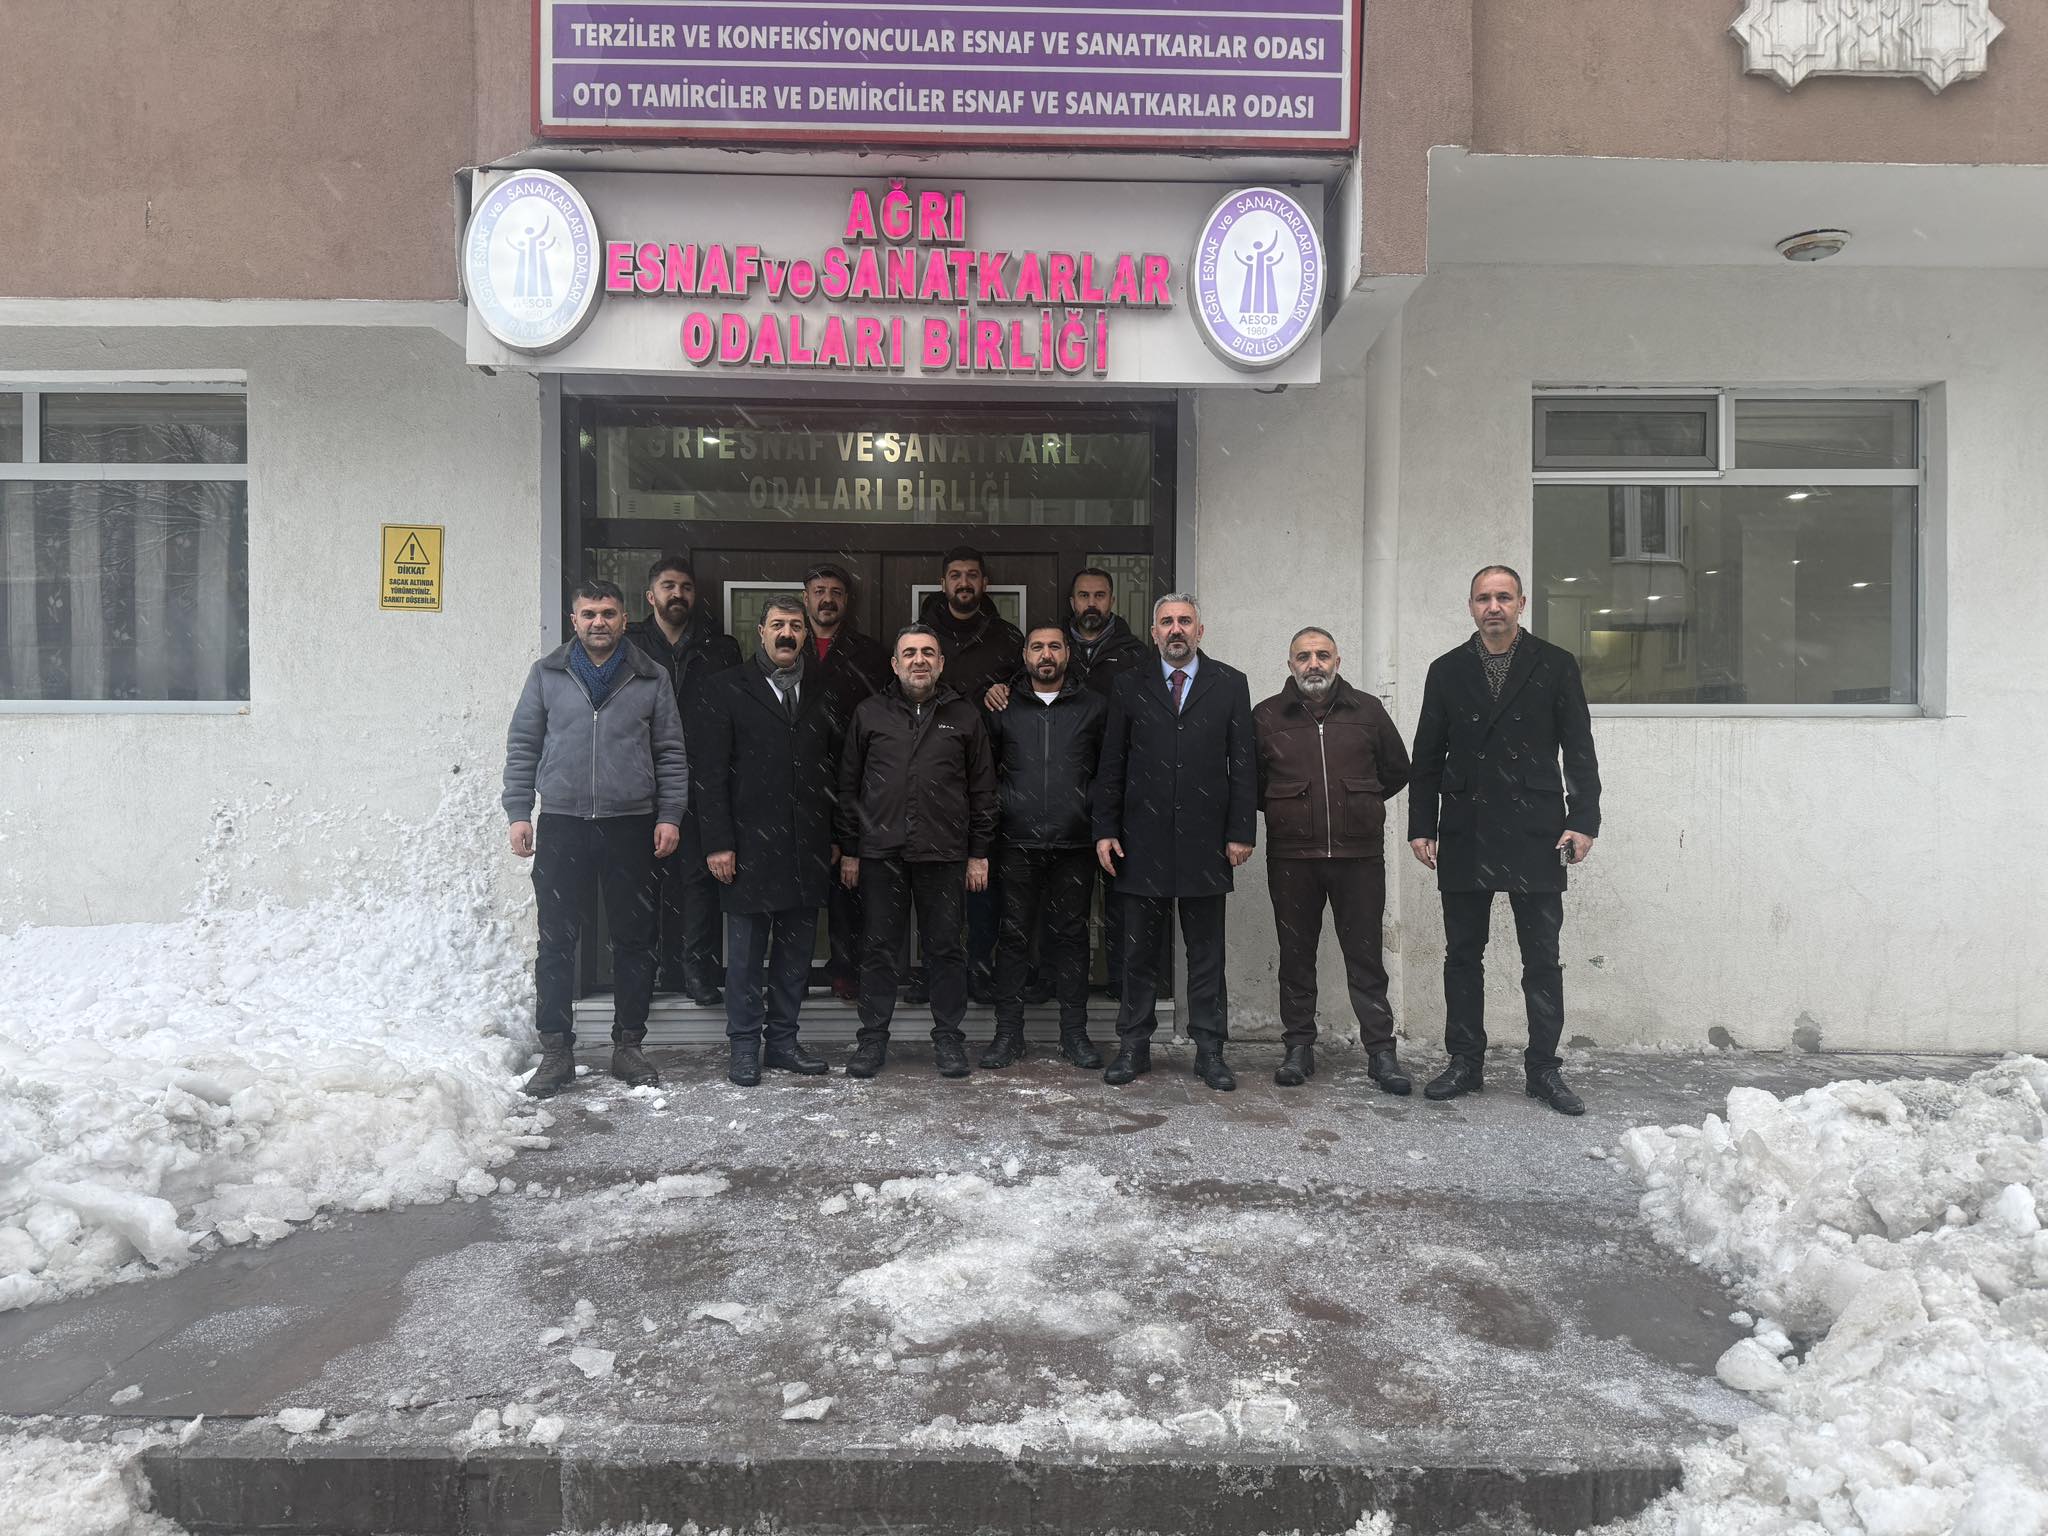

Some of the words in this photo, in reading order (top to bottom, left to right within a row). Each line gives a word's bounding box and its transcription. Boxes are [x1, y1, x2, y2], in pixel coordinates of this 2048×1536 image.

[570, 17, 676, 48] TERZİLER
[682, 24, 711, 49] VE
[717, 20, 956, 53] KONFEKSİYONCULAR
[962, 30, 1035, 55] ESNAF
[1041, 31, 1069, 55] VE
[1076, 32, 1247, 58] SANATKARLAR
[1253, 36, 1325, 61] ODASI
[573, 82, 622, 107] OTO
[628, 78, 767, 110] TAMİRCİLER
[773, 85, 802, 110] VE
[808, 80, 946, 112] DEMİRCİLER
[952, 89, 1025, 114] ESNAF
[1030, 90, 1059, 115] VE
[1065, 91, 1237, 118] SANATKARLAR
[1243, 95, 1314, 119] ODASI
[843, 177, 967, 246] AĞRI
[1218, 214, 1233, 231] ve
[1236, 196, 1313, 257] SANATKARLARI
[488, 203, 504, 219] ve
[506, 183, 585, 239] SANATKARLARI
[568, 242, 589, 304] ODALARI
[1203, 236, 1220, 281] ESNAF
[605, 239, 760, 300] ESNAF
[760, 256, 819, 301] ve
[820, 246, 1173, 309] SANATKARLAR
[1290, 260, 1315, 322] ODALARI
[1205, 289, 1225, 325] AĞRI
[1239, 314, 1278, 325] AESOB
[680, 311, 905, 373] ODALARI
[920, 306, 1110, 376] BİRLİĞİ
[1231, 335, 1284, 355] BİRLİĞİ
[718, 427, 824, 461] ESNAF
[836, 431, 874, 462] VE
[750, 475, 883, 511] ODALARI
[897, 471, 1011, 512] BİRLİĞİ
[397, 565, 426, 575] DİKKAT
